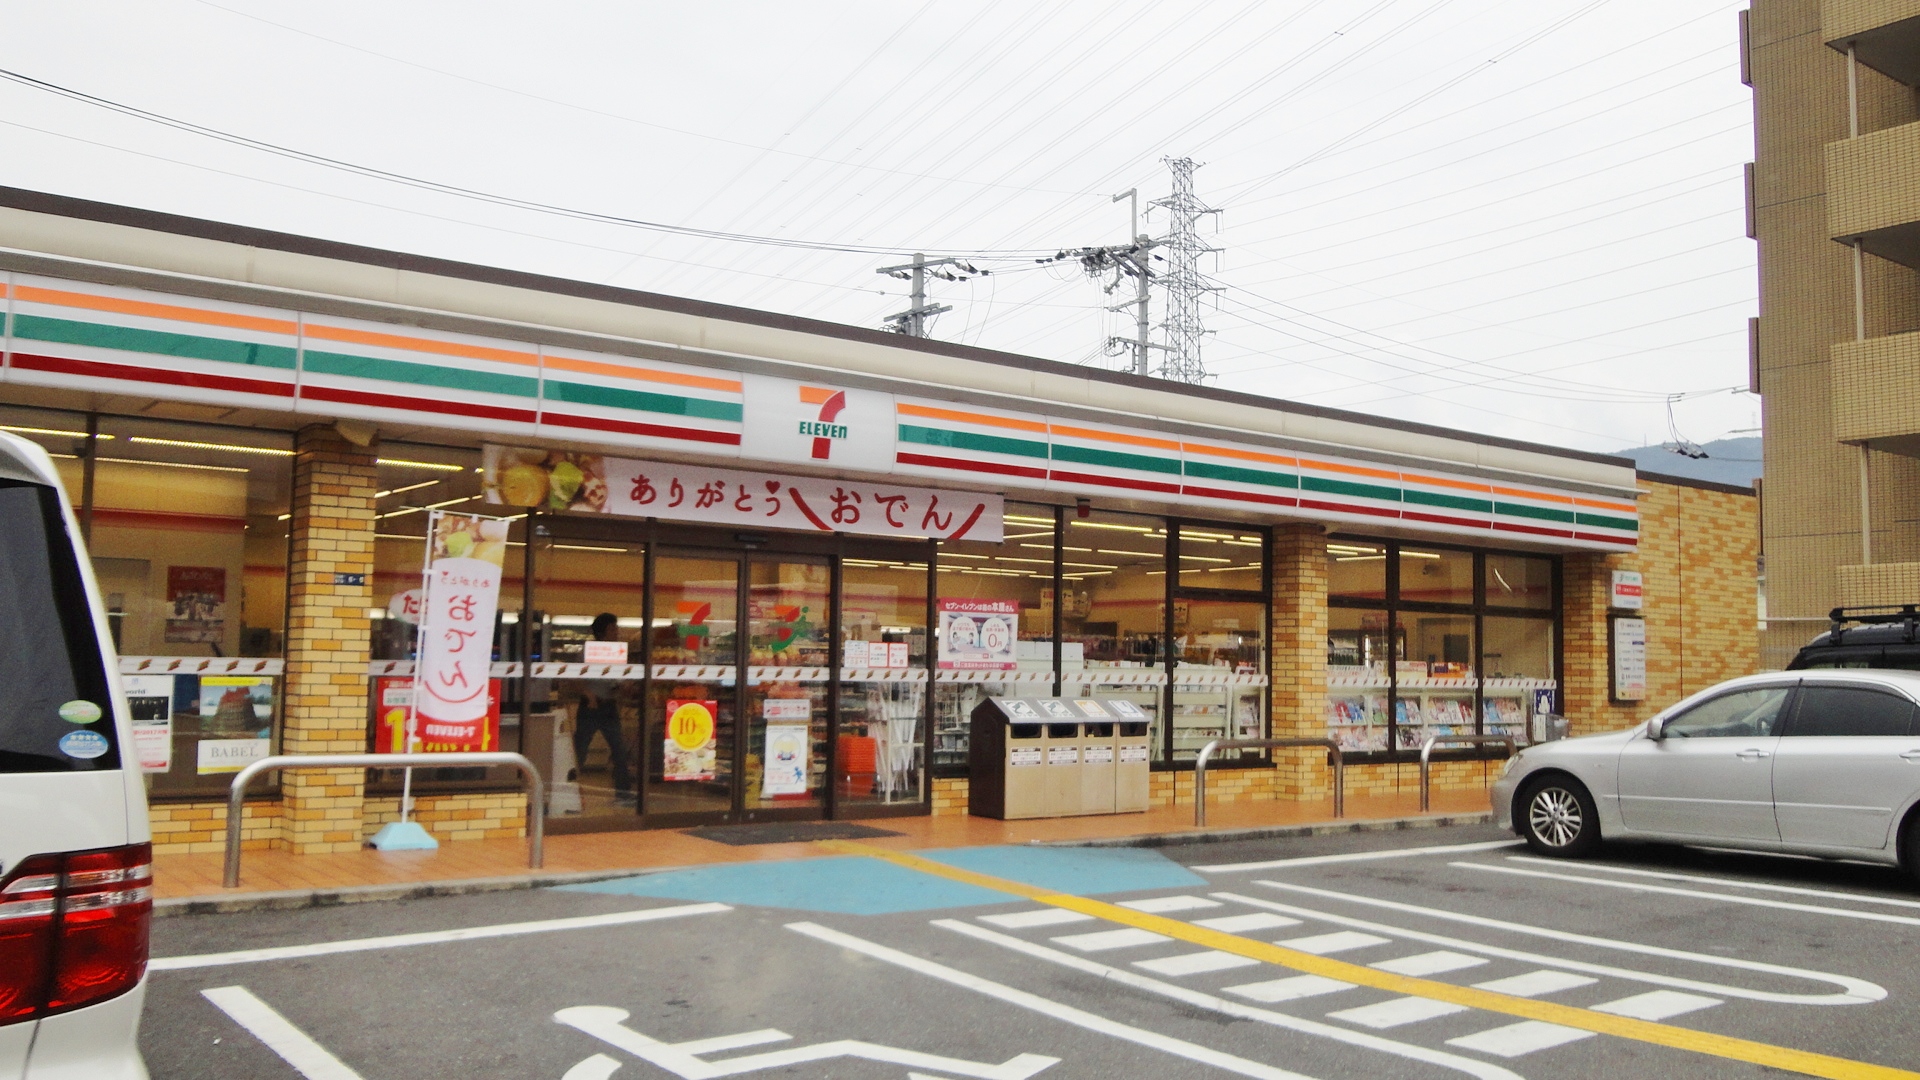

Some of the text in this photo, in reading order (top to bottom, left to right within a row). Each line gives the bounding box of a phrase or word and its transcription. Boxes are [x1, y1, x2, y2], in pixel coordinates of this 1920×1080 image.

[799, 385, 846, 459] 7
[630, 473, 954, 531] ありがとう おでん
[210, 746, 259, 759] BABEL
